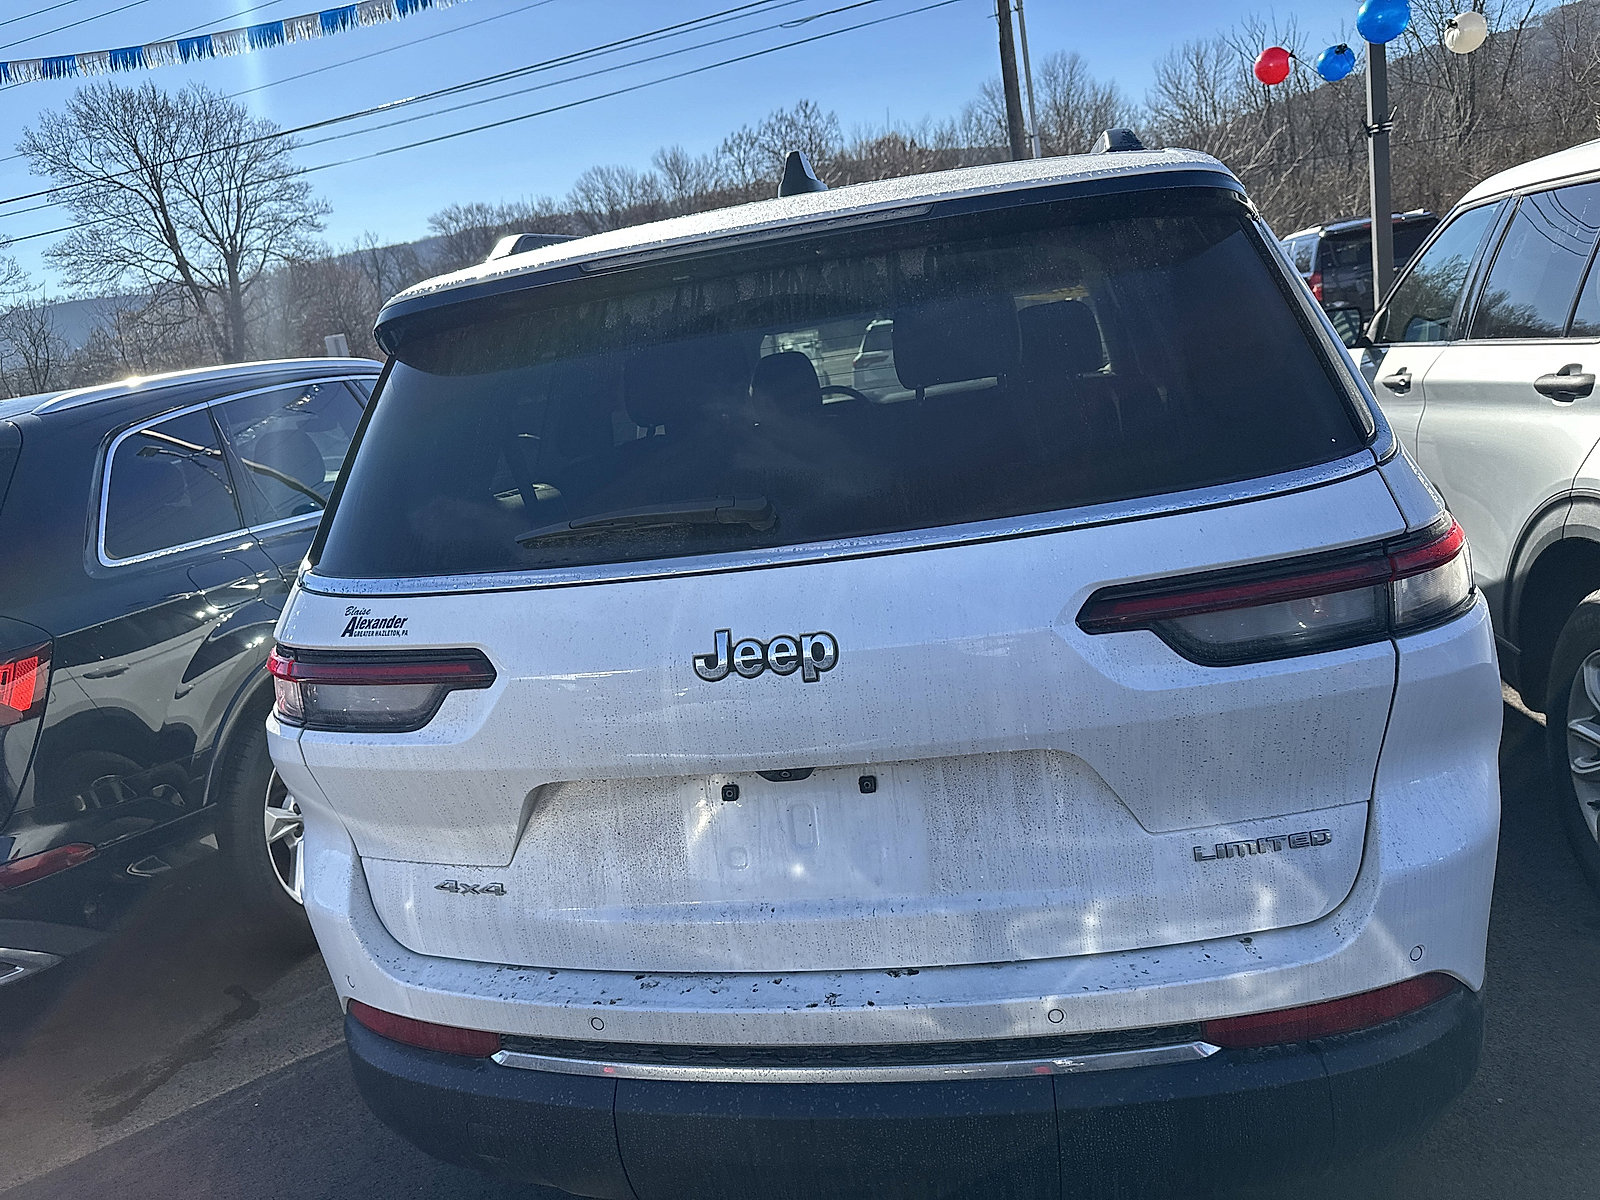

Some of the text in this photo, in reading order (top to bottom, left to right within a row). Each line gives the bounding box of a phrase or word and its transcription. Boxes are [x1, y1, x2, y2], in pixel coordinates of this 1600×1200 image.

[345, 606, 371, 616] Blaise
[341, 615, 408, 637] Alexander
[693, 628, 839, 682] Jeep
[1193, 829, 1332, 862] LIMITED
[434, 880, 507, 896] 4x4
